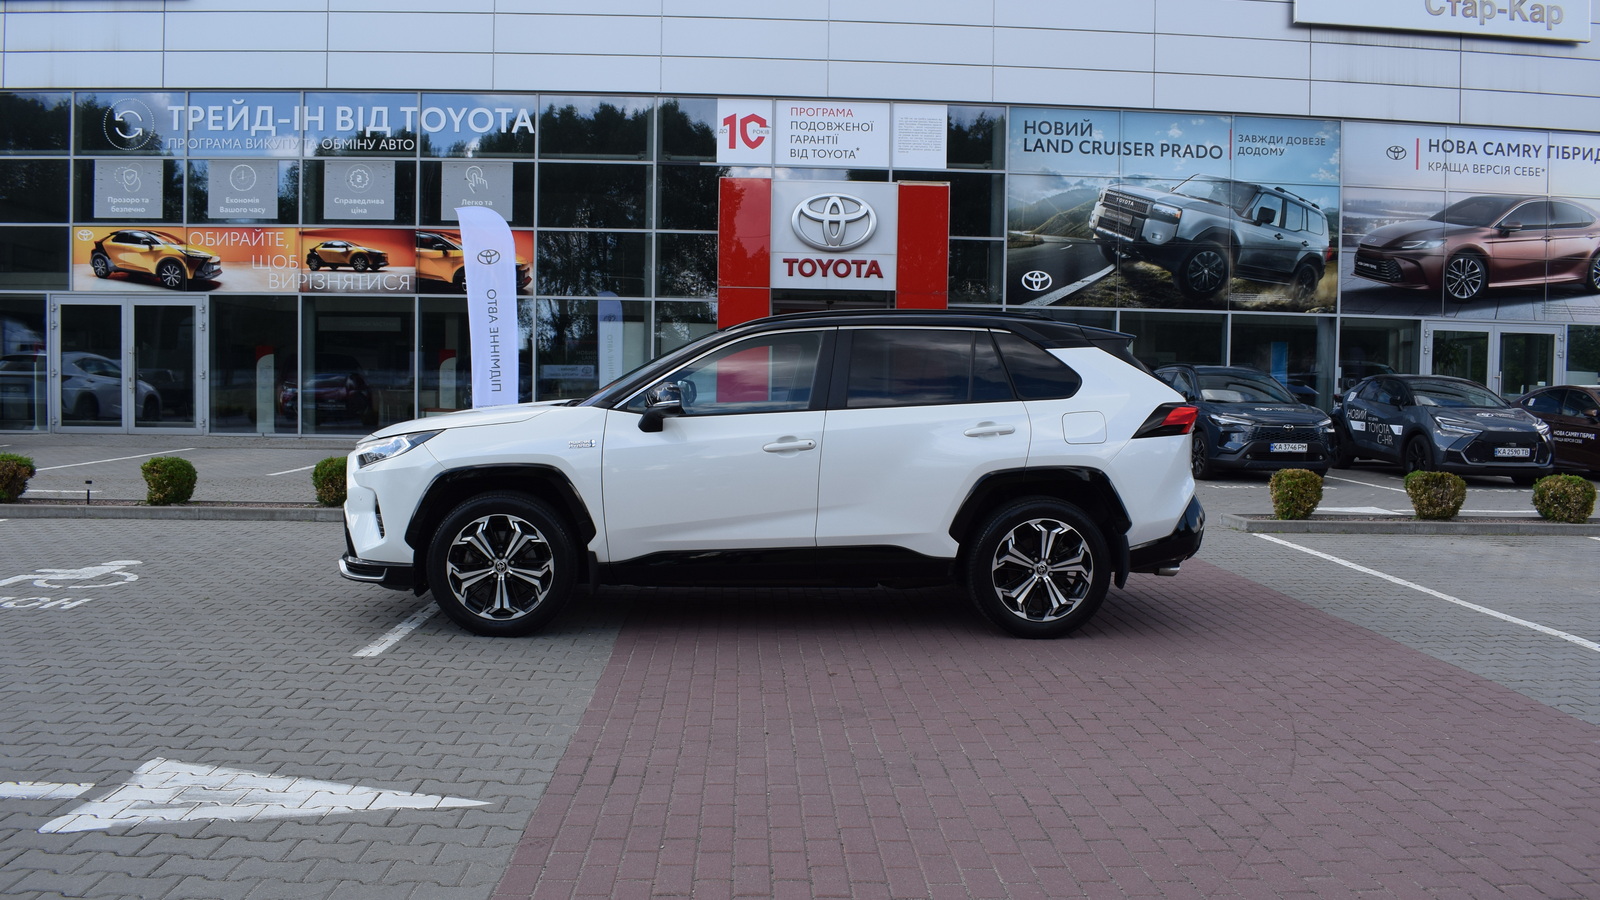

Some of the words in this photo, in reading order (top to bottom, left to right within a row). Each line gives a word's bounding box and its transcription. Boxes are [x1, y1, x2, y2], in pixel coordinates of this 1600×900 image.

[1424, 0, 1564, 31] Стар-Кар
[167, 99, 324, 137] ТРЕЙД-ІН
[336, 106, 391, 137] ВІД
[400, 107, 535, 134] TOYOTA
[790, 107, 854, 118] ПРОГРАМА
[790, 120, 875, 132] ПОДОВЖЕНОЇ
[1024, 119, 1093, 137] НОВИЙ
[168, 138, 242, 150] ПРОГРАМА
[246, 138, 299, 150] ВИКУПУ
[302, 139, 318, 150] ТА
[321, 138, 375, 150] ОБМІНУ
[378, 138, 415, 151] АВТО
[790, 134, 839, 145] ГАРАНТІЇ
[1238, 134, 1283, 146] ЗАВЖДИ
[1285, 136, 1326, 146] ДОВЕЗЕ
[789, 148, 809, 160] ВІД
[1023, 138, 1074, 154] LAND
[1078, 140, 1155, 157] CRUISER
[1160, 143, 1223, 160] PRADO
[1237, 146, 1285, 157] ДОДОМУ
[1428, 139, 1478, 155] НОВА
[1482, 142, 1542, 159] CAMRY
[1428, 161, 1469, 174] КРАЩА
[1472, 164, 1511, 175] ВЕРСІЯ
[107, 197, 140, 205] Прозоро
[334, 197, 385, 206] Справедлива
[249, 207, 266, 215] часу
[351, 206, 367, 214] ціна
[189, 228, 289, 249] ОБИРАЙТЕ,
[251, 254, 299, 271] ЩОБ
[783, 258, 884, 279] TOYOTA
[268, 273, 410, 291] ВИРІЗНЯТИСЯ
[1346, 409, 1367, 420] НОВИЙ
[1368, 422, 1391, 434] TOYOTA
[1377, 434, 1393, 445] C-HR
